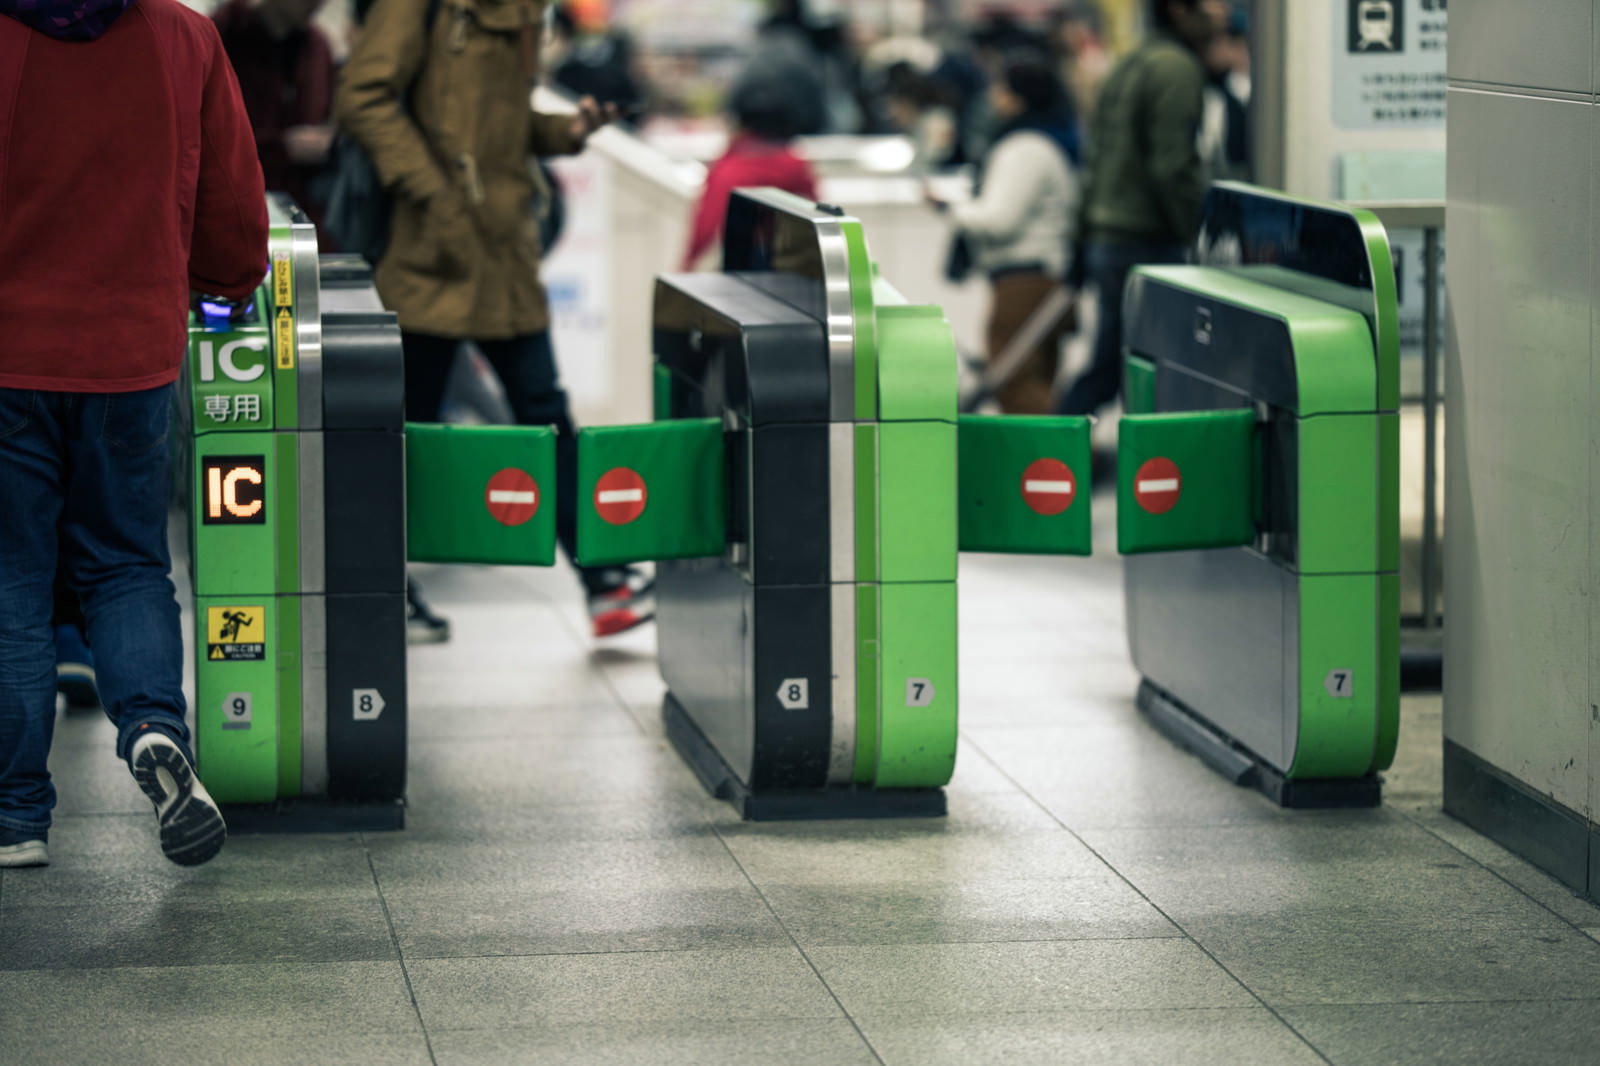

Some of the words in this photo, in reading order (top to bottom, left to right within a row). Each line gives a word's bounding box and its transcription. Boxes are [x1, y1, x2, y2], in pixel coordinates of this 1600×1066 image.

[200, 338, 265, 382] IC
[204, 394, 260, 422] 専用
[208, 467, 262, 517] IC
[1334, 673, 1346, 692] 7
[787, 684, 801, 702] 8
[912, 683, 925, 701] 7
[232, 698, 246, 716] 9
[359, 694, 373, 712] 8
